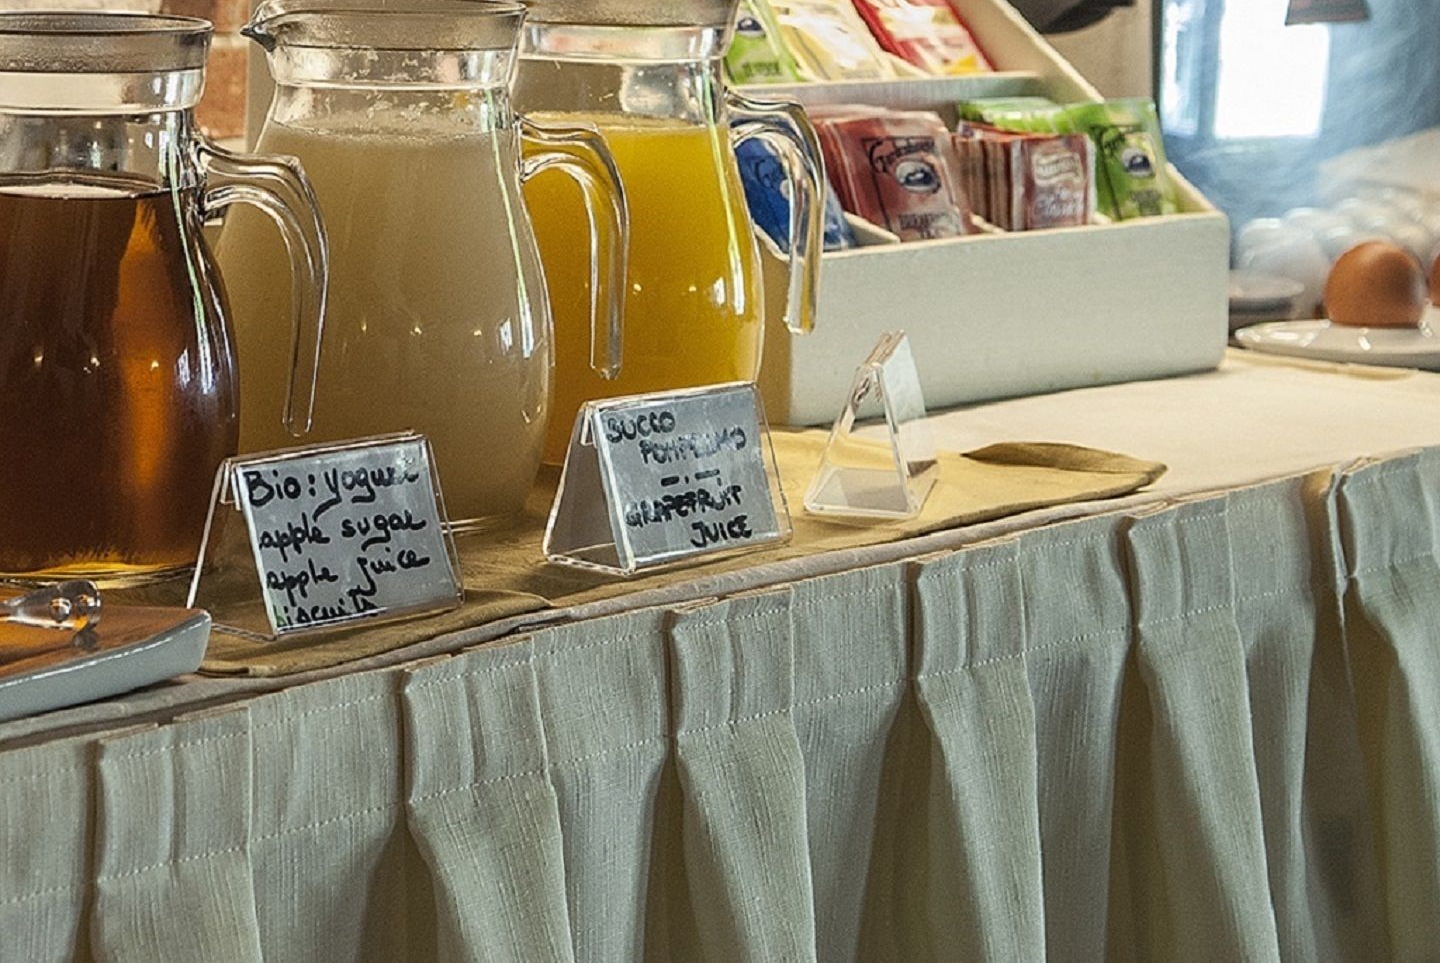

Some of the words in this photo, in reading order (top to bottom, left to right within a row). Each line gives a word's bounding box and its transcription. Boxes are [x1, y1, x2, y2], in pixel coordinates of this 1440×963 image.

[605, 411, 676, 443] SUCCO
[242, 469, 317, 507] Bio:
[258, 513, 331, 562] apple
[341, 509, 427, 552] sugar
[690, 514, 753, 548] JUICE
[266, 558, 339, 607] apple
[355, 547, 430, 596] juice
